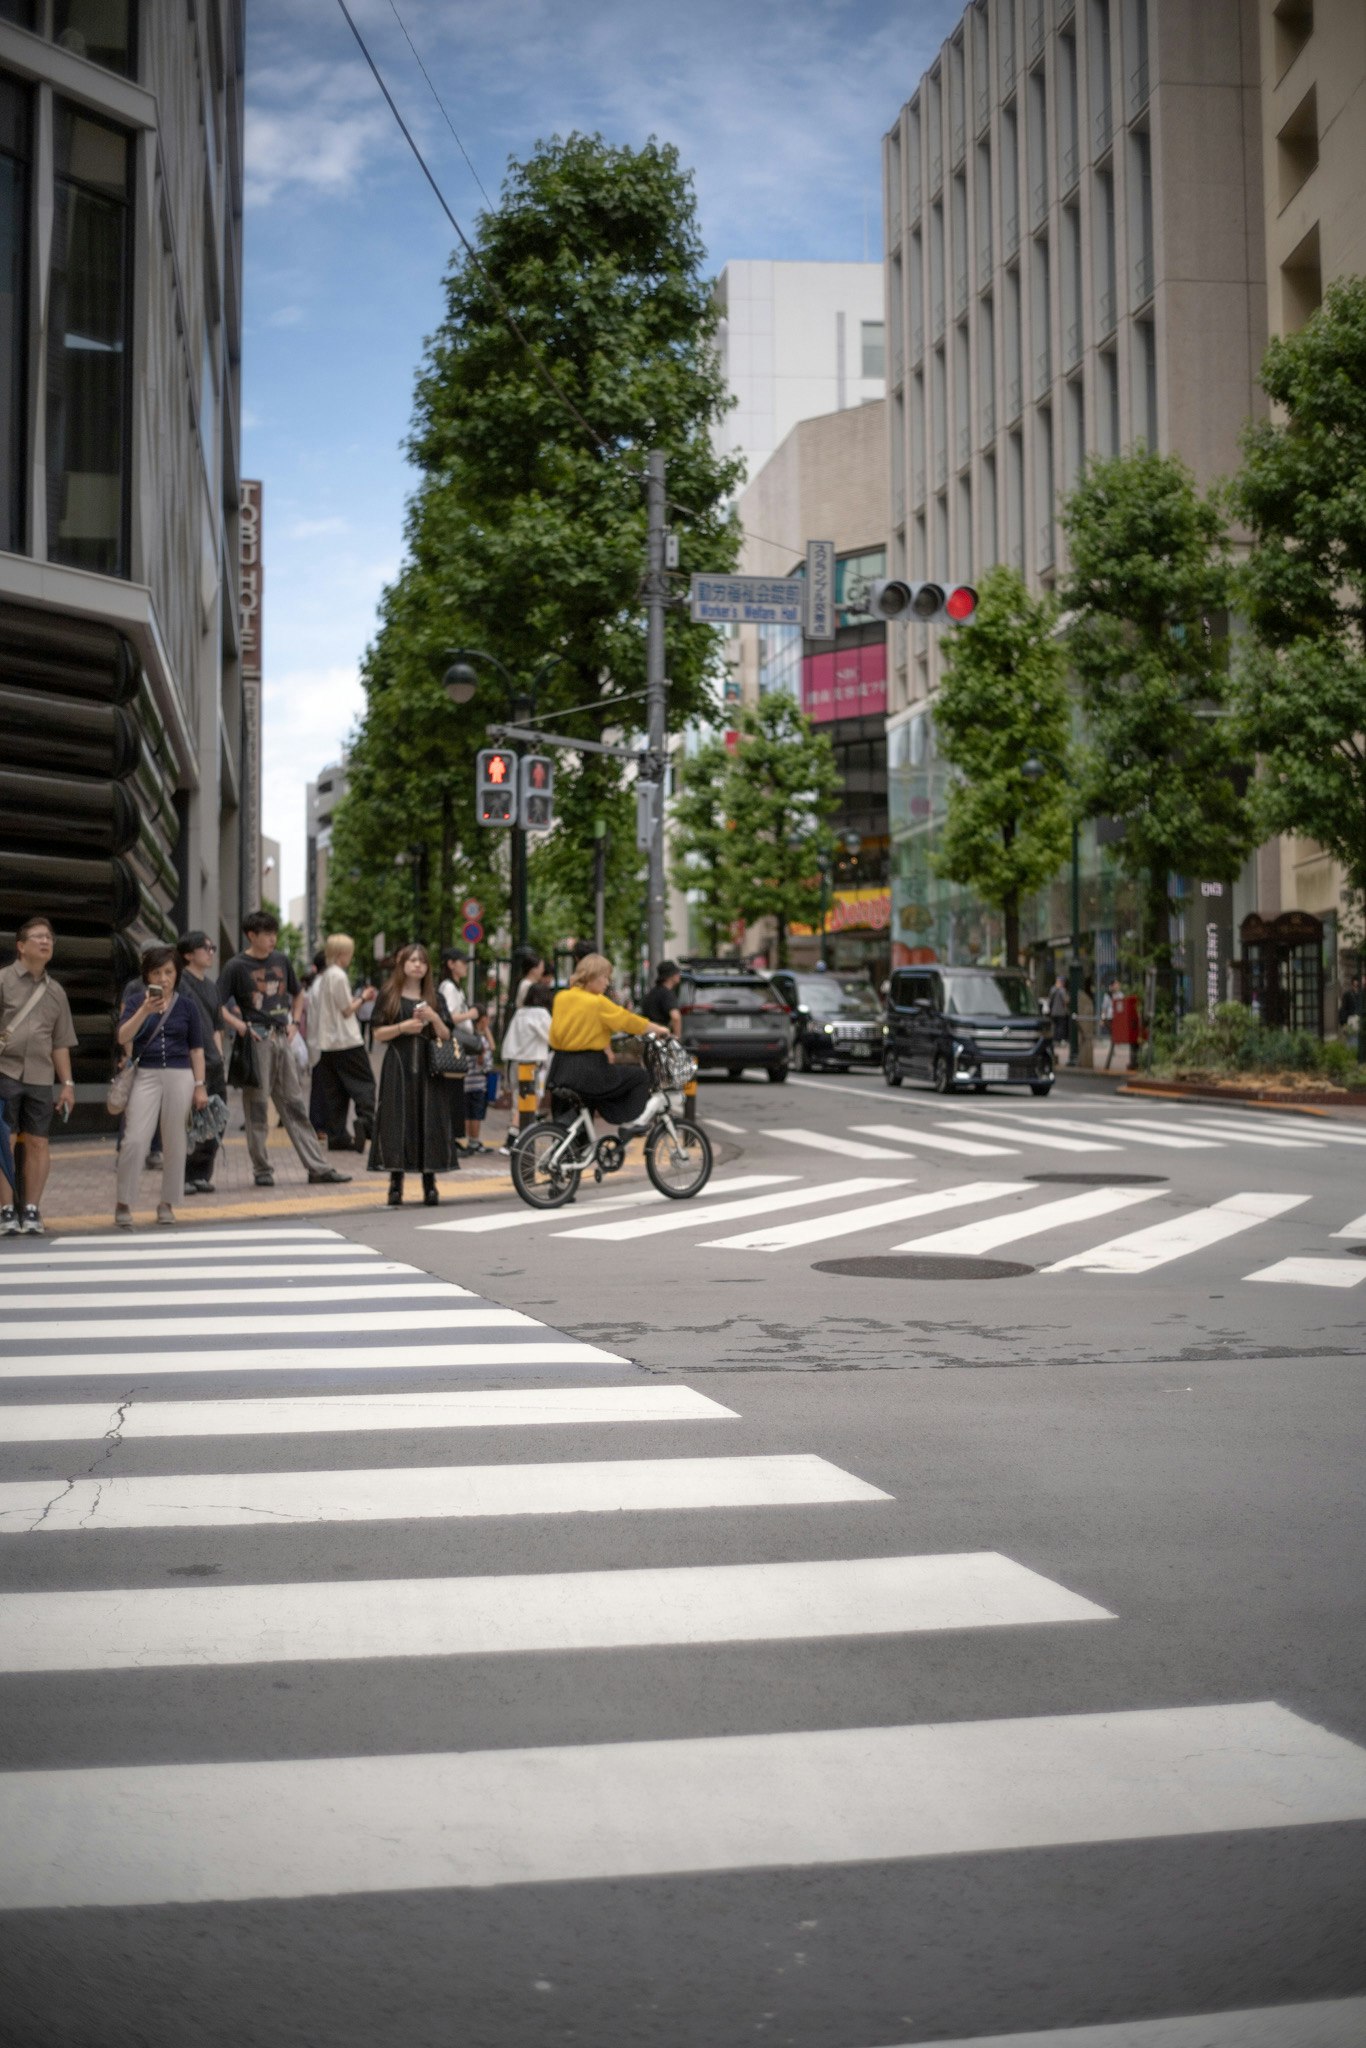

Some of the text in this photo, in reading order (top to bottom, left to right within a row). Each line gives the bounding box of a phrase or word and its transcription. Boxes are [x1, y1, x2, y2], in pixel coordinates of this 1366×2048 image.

[697, 581, 800, 605] 勤労福祉会館前
[781, 606, 799, 621] Hall
